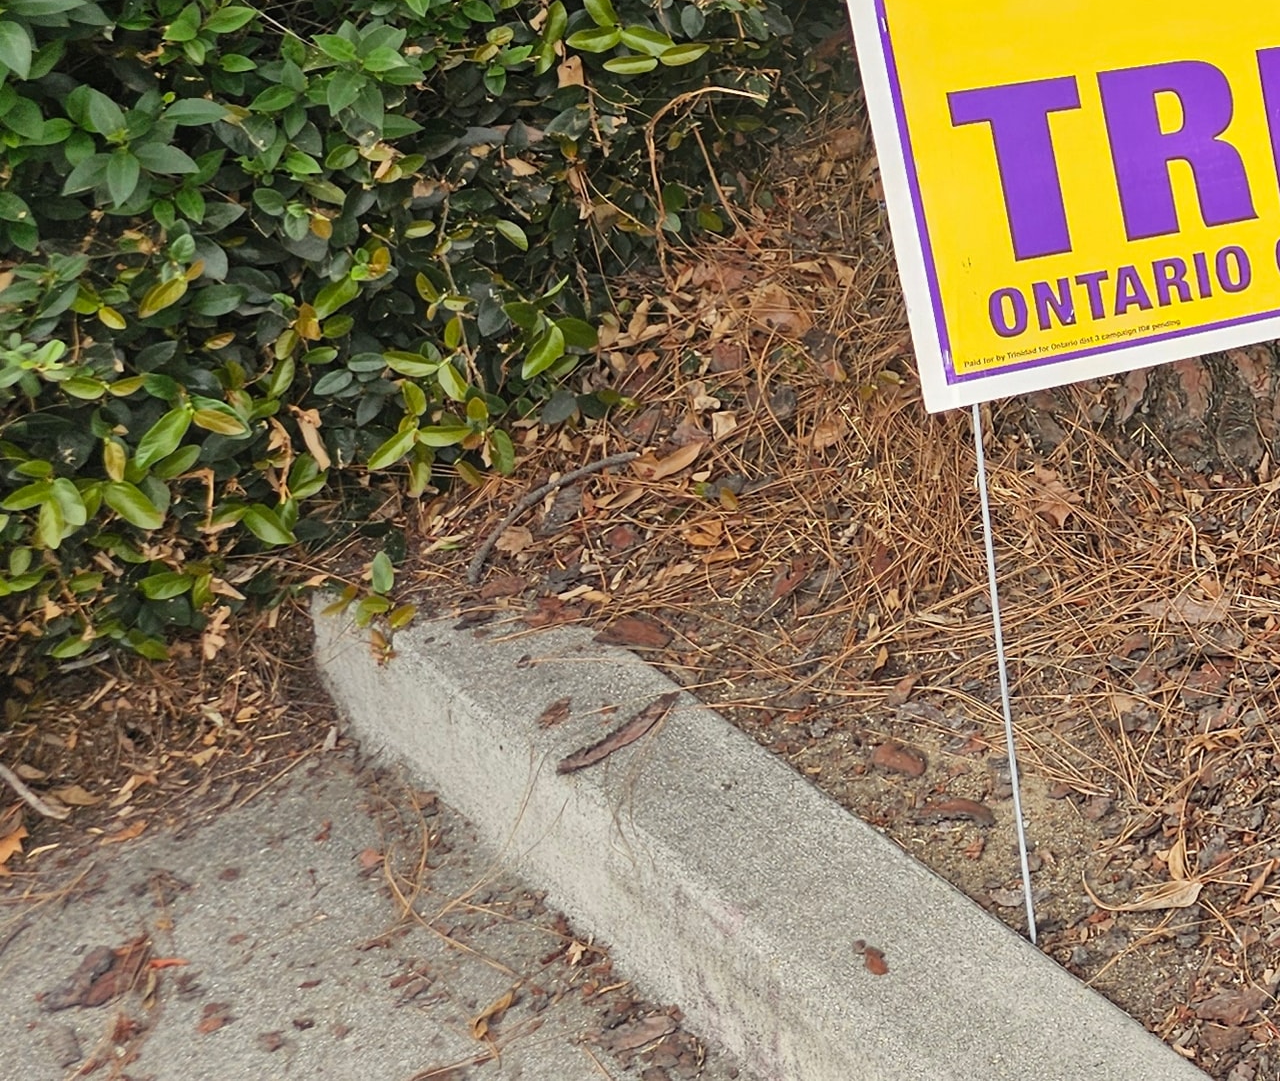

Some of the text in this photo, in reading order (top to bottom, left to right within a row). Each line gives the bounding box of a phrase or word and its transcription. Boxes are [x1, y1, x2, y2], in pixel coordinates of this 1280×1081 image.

[988, 246, 1252, 338] ONTARIO
[964, 358, 981, 368] Paid
[983, 356, 994, 364] for
[996, 354, 1005, 362] by
[1007, 347, 1037, 359] Trinidad
[1039, 345, 1049, 353] for
[1051, 340, 1077, 351] Ontario
[1079, 335, 1093, 345] dist
[1101, 327, 1137, 340] campaign
[1152, 319, 1181, 331] pending
